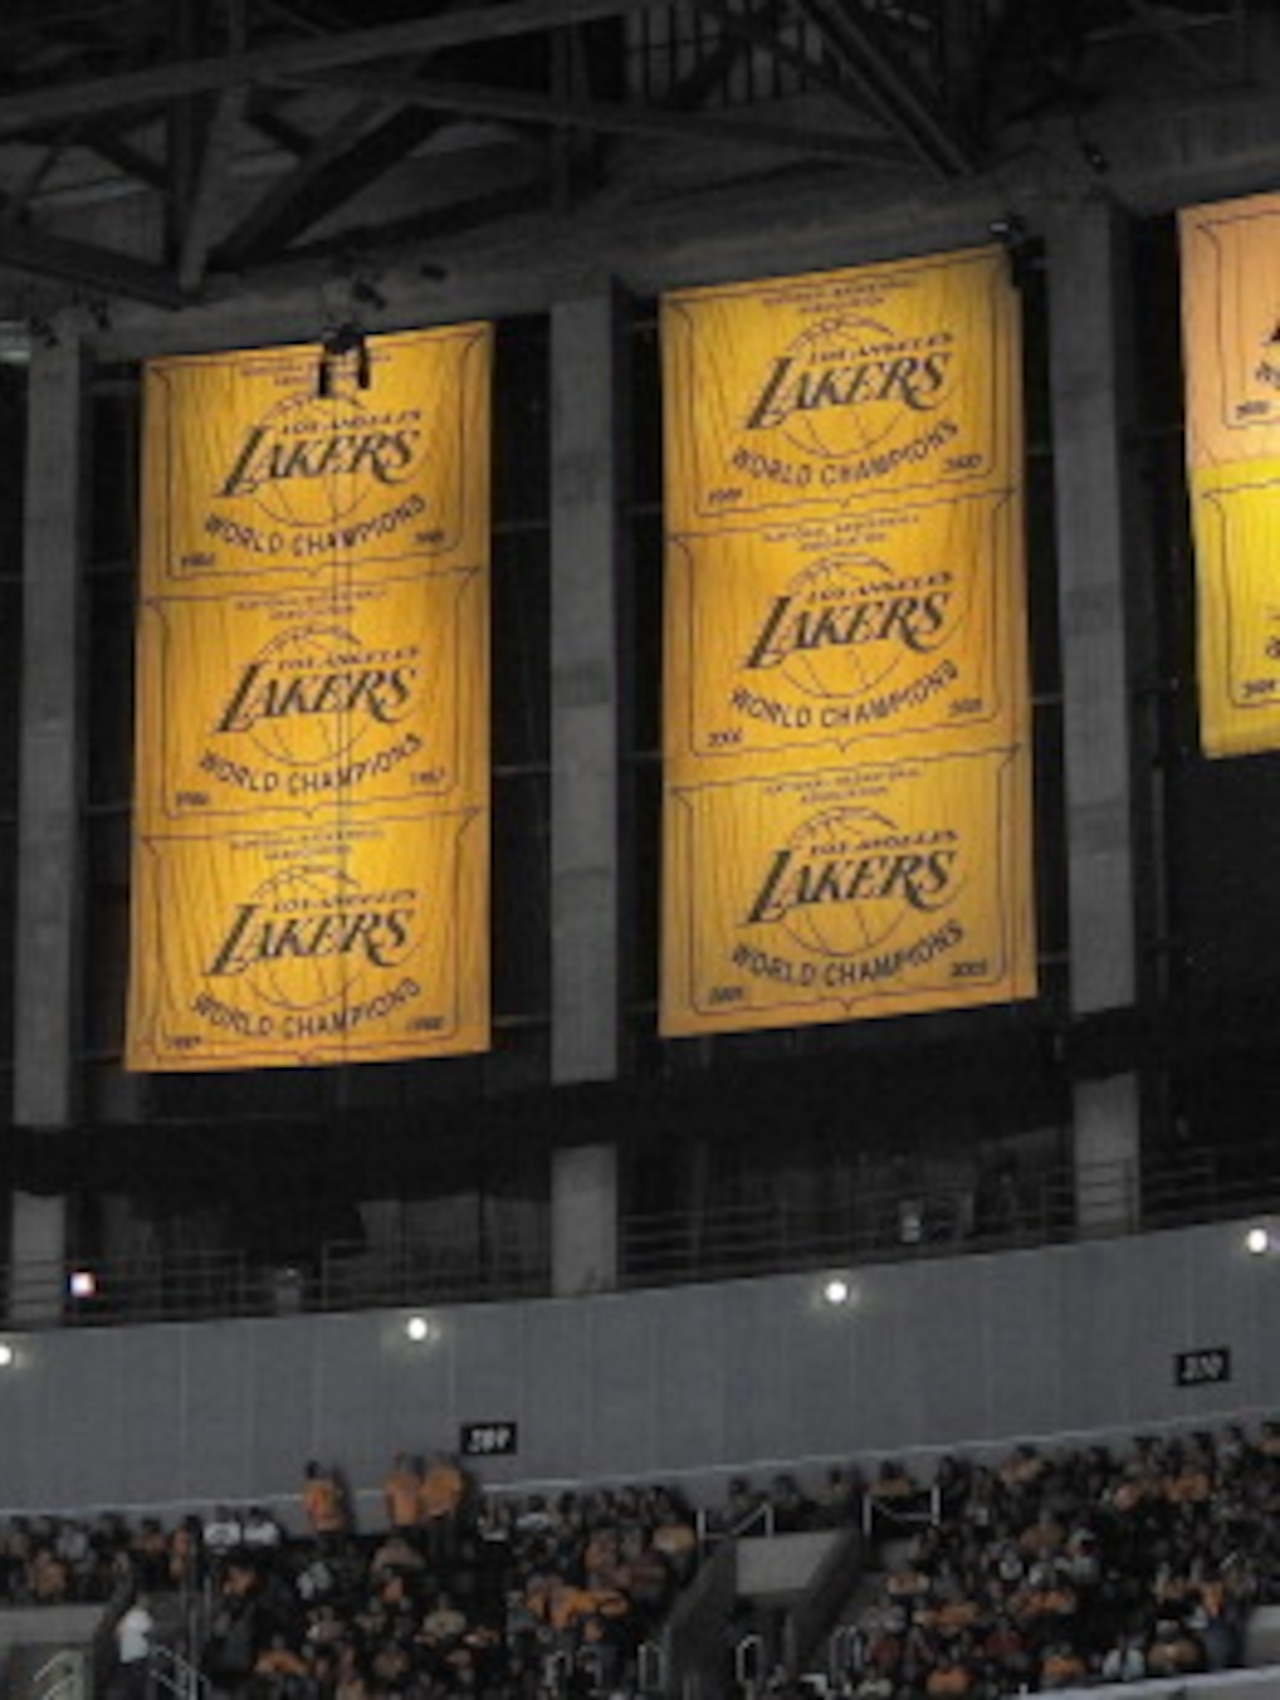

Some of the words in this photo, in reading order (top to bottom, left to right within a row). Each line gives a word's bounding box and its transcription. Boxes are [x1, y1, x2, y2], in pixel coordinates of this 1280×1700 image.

[744, 356, 952, 431] LAKERS
[218, 426, 421, 499] LAKERS
[731, 445, 812, 488] WORLD
[820, 416, 960, 488] CHAMPIONS
[204, 512, 284, 555] WORLD
[292, 492, 427, 557] CHAMPIONS
[742, 591, 952, 670] LAKERS
[214, 663, 418, 734] LAKERS
[730, 686, 812, 728] WORLD
[821, 658, 960, 728] CHAMPIONS
[198, 747, 279, 793] WORLD
[287, 731, 425, 796] CHAMPIONS
[740, 850, 958, 926] LAKERS
[202, 903, 417, 978] LAKERS
[731, 942, 816, 987] WORLD
[823, 918, 965, 987] CHAMPIONS
[191, 992, 275, 1038] WORLD
[282, 976, 422, 1041] CHAMPIONS
